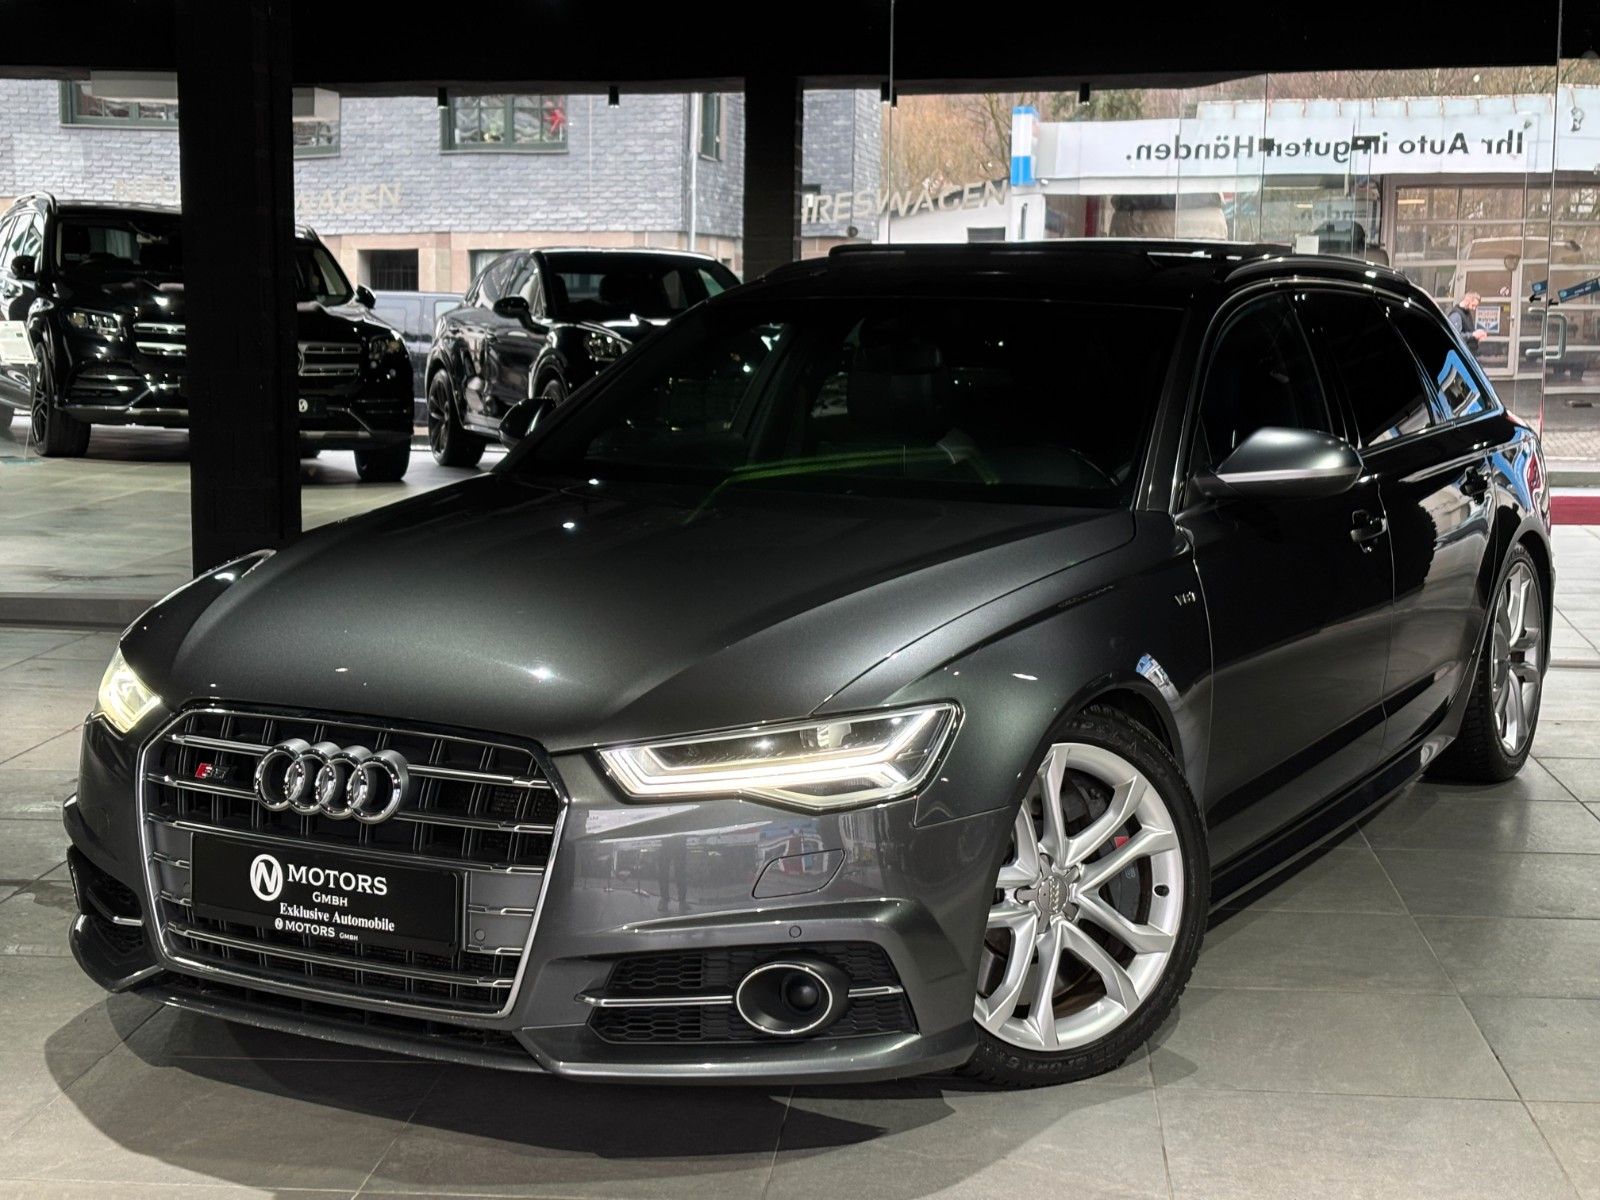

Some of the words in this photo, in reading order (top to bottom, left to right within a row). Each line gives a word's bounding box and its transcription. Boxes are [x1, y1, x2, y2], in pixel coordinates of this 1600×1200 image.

[287, 863, 388, 896] MOTORS
[312, 891, 348, 907] GMBH
[280, 902, 330, 922] Exklusive
[332, 911, 395, 932] Automobile
[285, 920, 336, 938] MOTORS
[339, 932, 359, 941] GMBH
